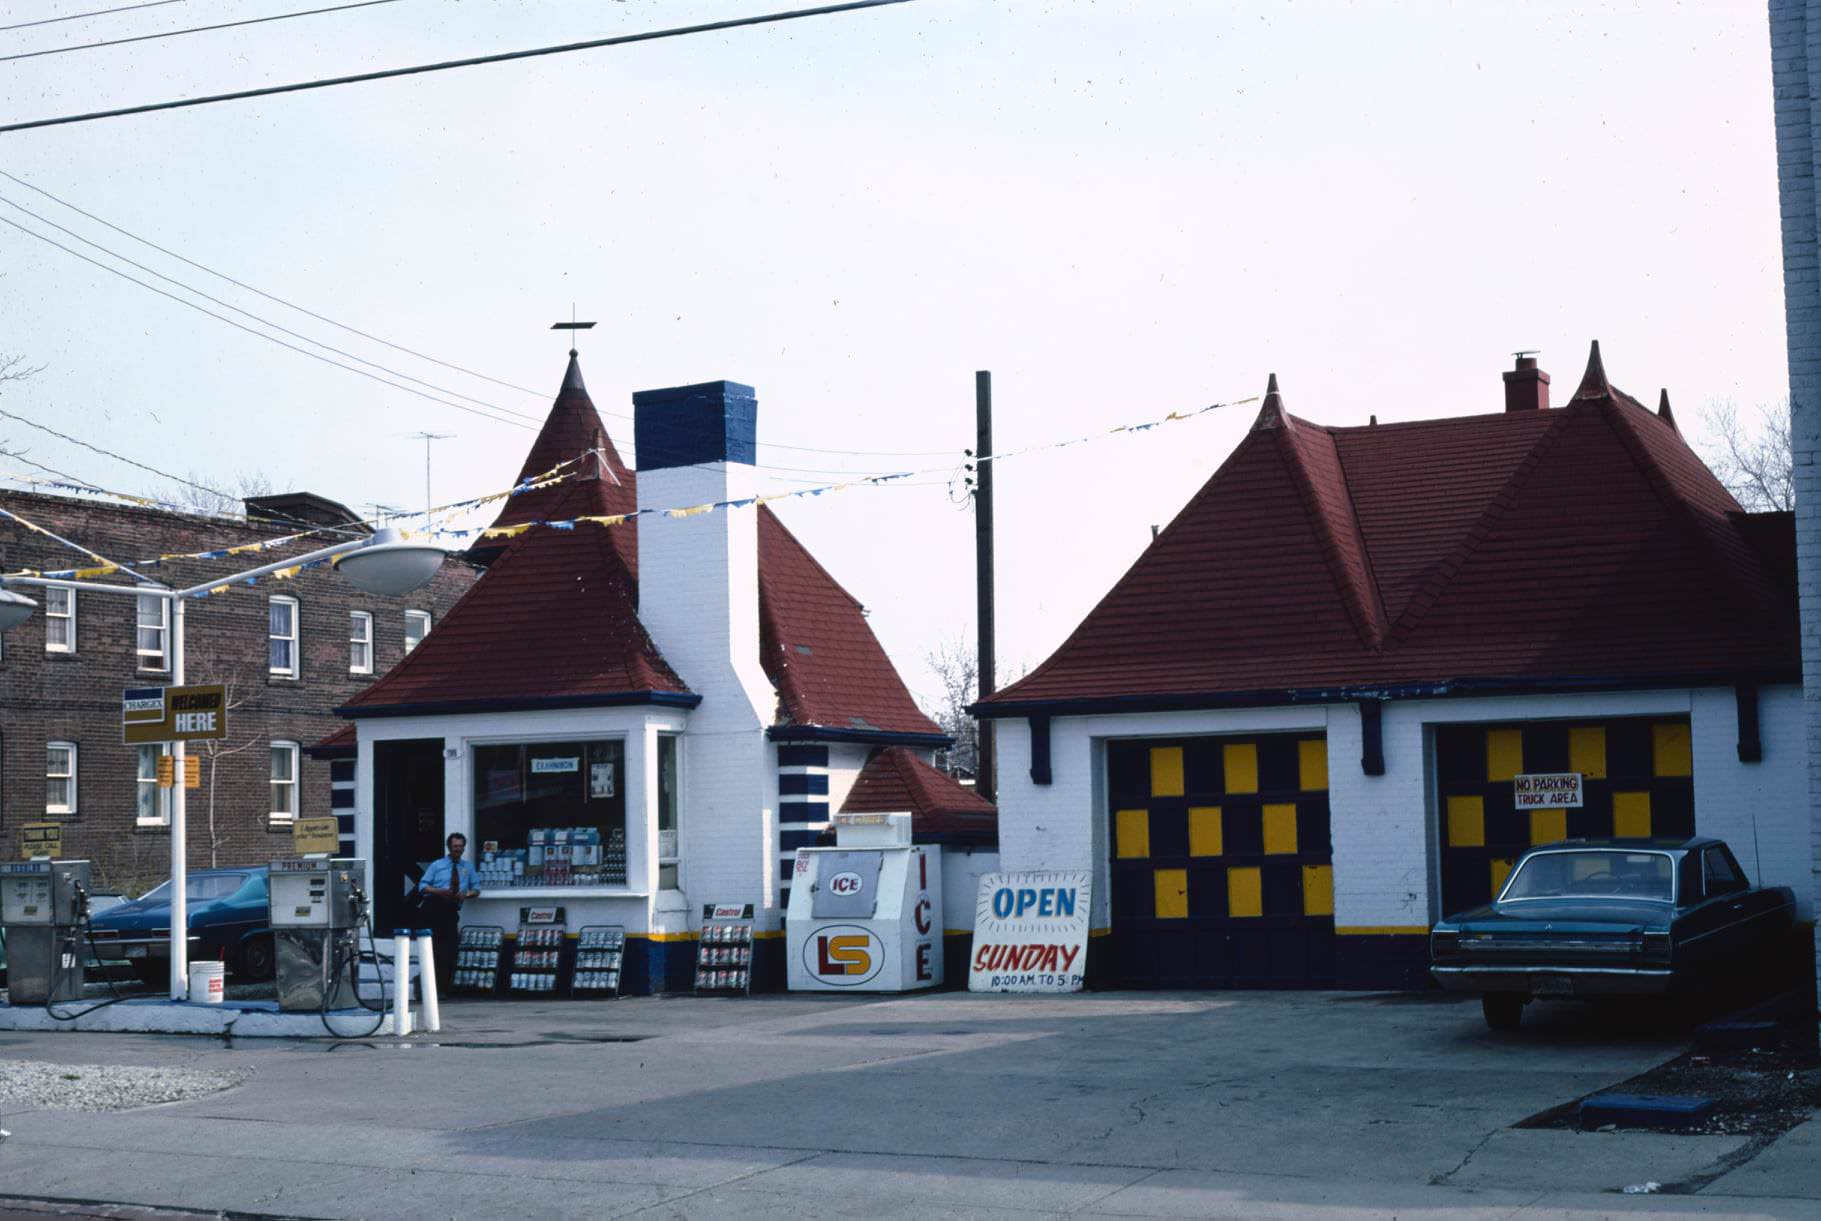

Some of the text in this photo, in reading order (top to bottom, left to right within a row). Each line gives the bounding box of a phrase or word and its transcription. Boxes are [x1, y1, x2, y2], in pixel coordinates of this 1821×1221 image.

[175, 712, 217, 732] HERE
[1517, 776, 1577, 790] NO PARKING
[1518, 792, 1578, 805] TRUCK AREA
[281, 861, 317, 870] PREMIUM
[832, 877, 859, 892] ICE
[993, 887, 1076, 918] OPEN
[530, 910, 553, 920] Castrol
[714, 907, 740, 917] Castrol
[817, 925, 871, 976] LS
[973, 943, 1081, 973] SUNDAY
[991, 974, 1017, 987] 10:00
[1039, 975, 1054, 986] TO
[1057, 974, 1066, 986] 5
